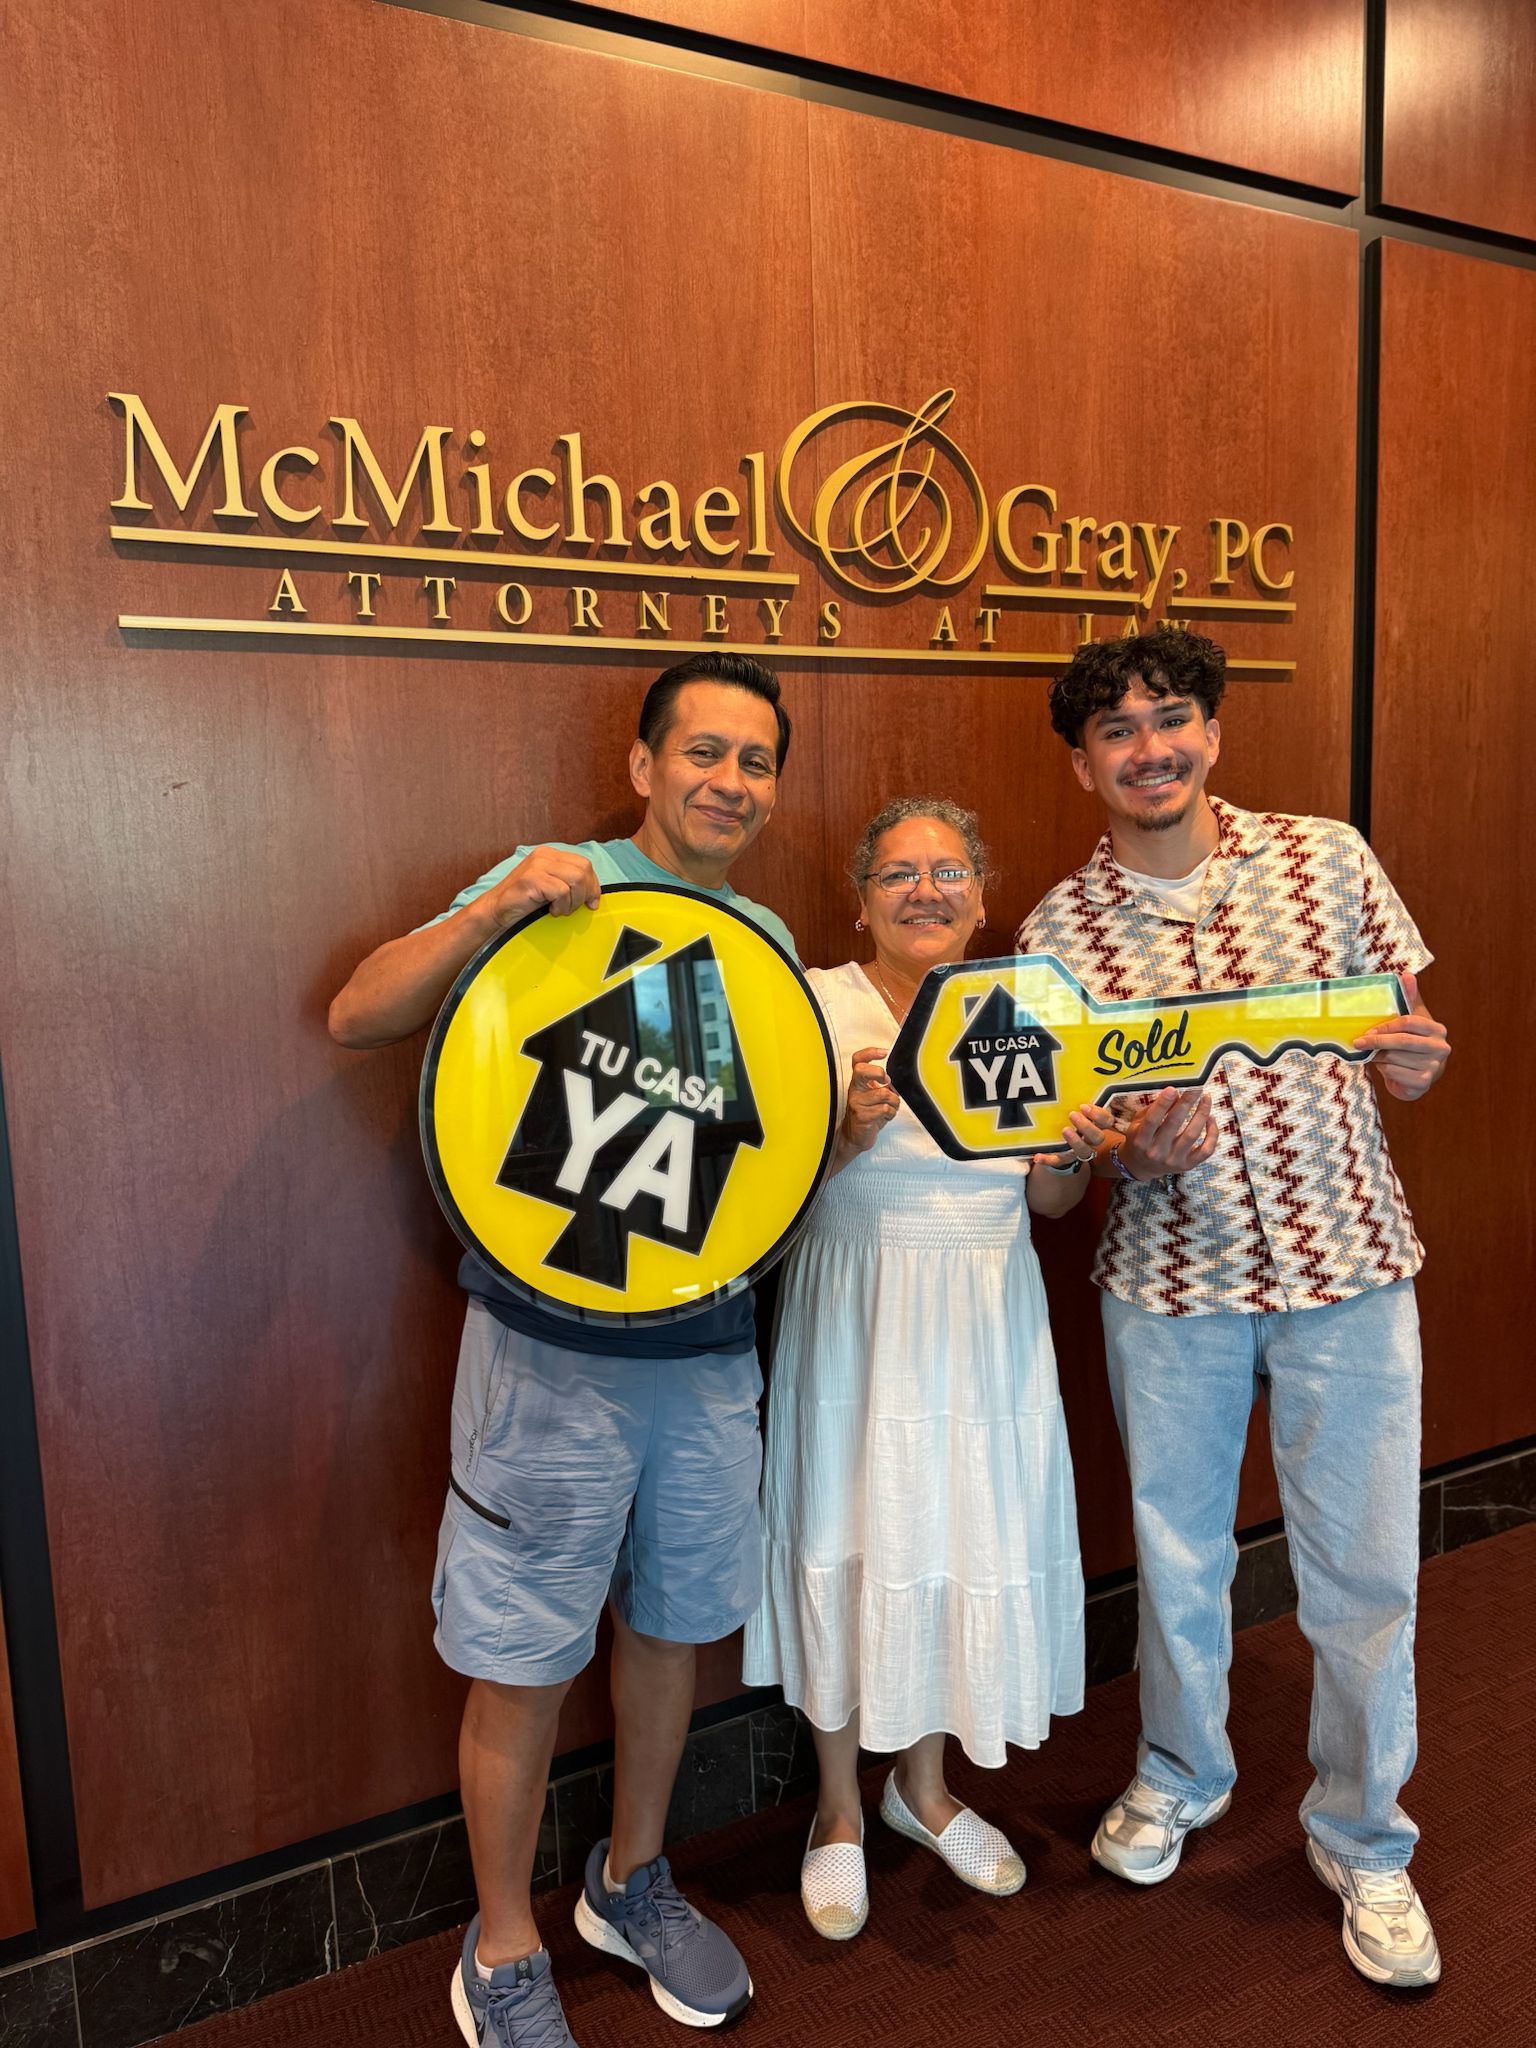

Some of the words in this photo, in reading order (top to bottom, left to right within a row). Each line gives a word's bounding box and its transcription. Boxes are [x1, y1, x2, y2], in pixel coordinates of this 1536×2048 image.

[107, 392, 775, 557] McMichael
[994, 484, 1189, 608] Gray,
[1210, 517, 1295, 591] PC
[269, 567, 842, 641] ATTORNEYS
[931, 606, 1002, 644] AT
[580, 1030, 630, 1077] TU
[633, 1057, 725, 1120] CASA
[968, 1039, 991, 1055] TU
[994, 1034, 1041, 1052] CASA
[968, 1052, 1049, 1102] YA
[1092, 1010, 1192, 1076] Sold
[554, 1068, 695, 1233] YA
